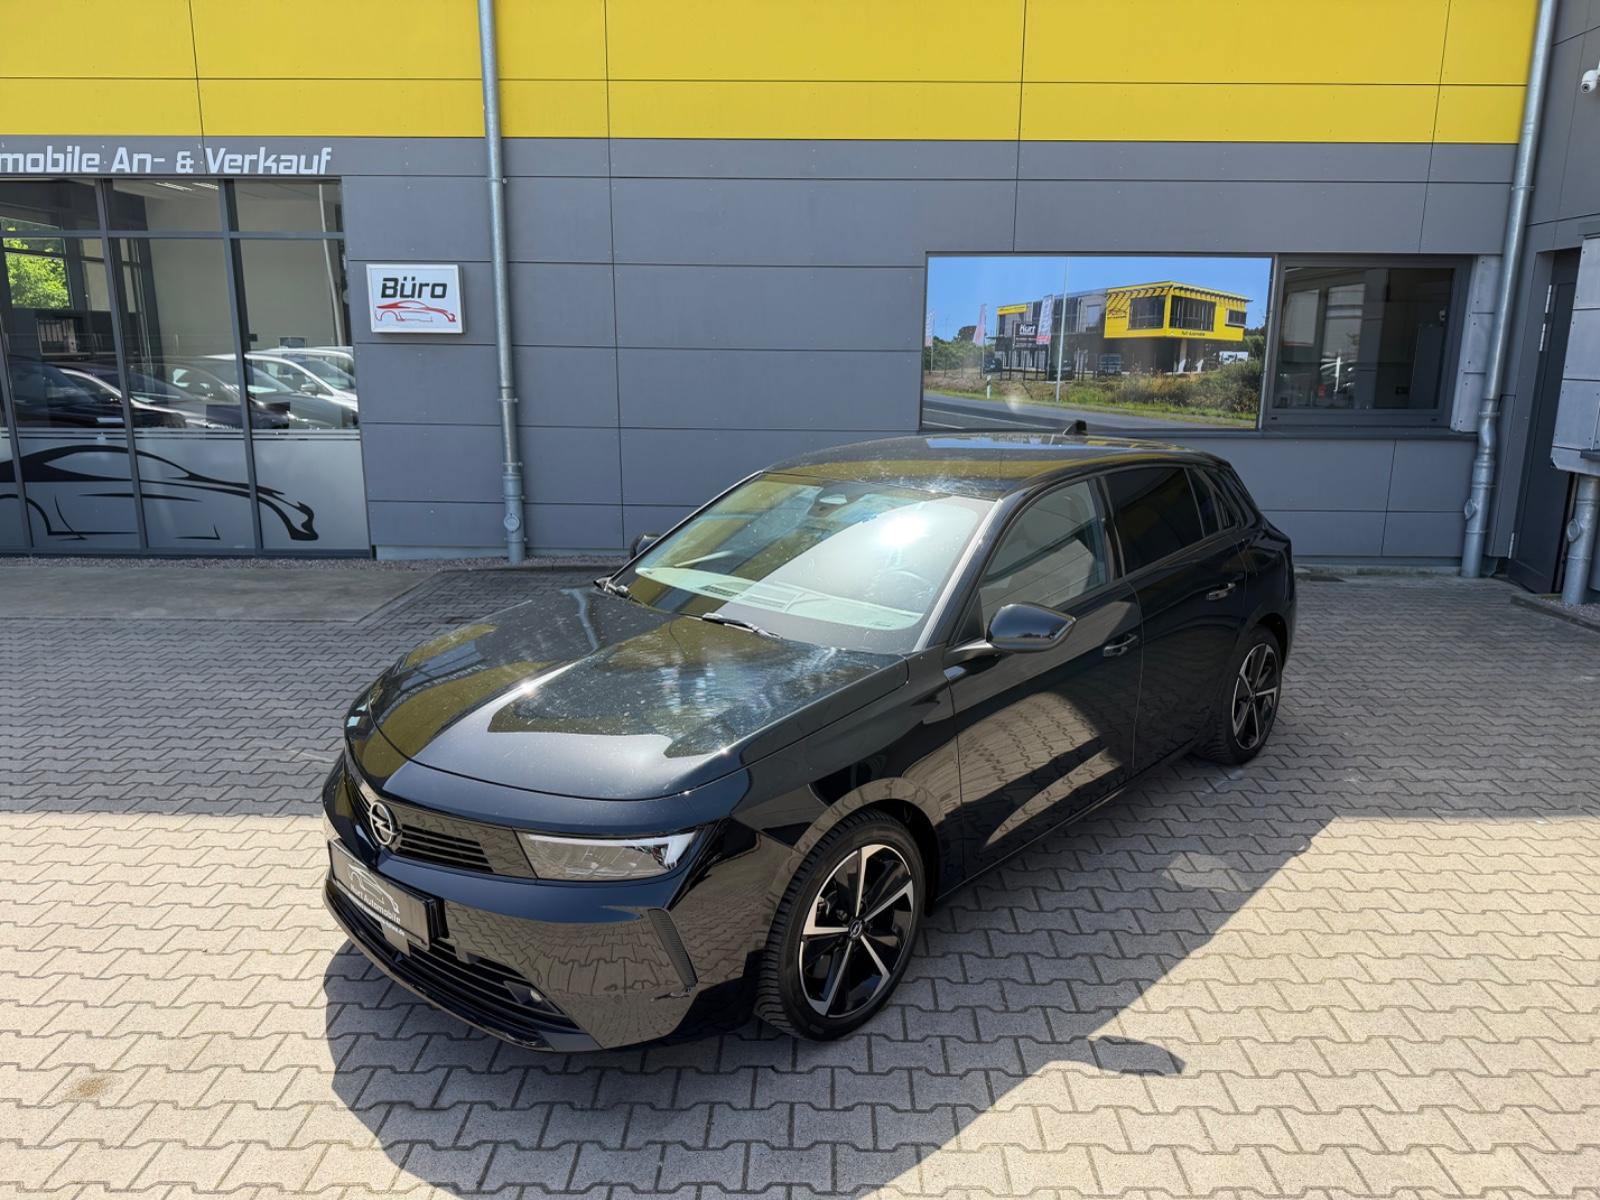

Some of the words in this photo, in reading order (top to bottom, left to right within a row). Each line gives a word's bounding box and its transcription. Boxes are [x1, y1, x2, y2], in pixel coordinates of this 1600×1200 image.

[0, 145, 100, 173] mobile
[110, 146, 165, 174] An-
[175, 149, 194, 174] &
[205, 146, 332, 175] Verkauf
[381, 276, 448, 299] Büro
